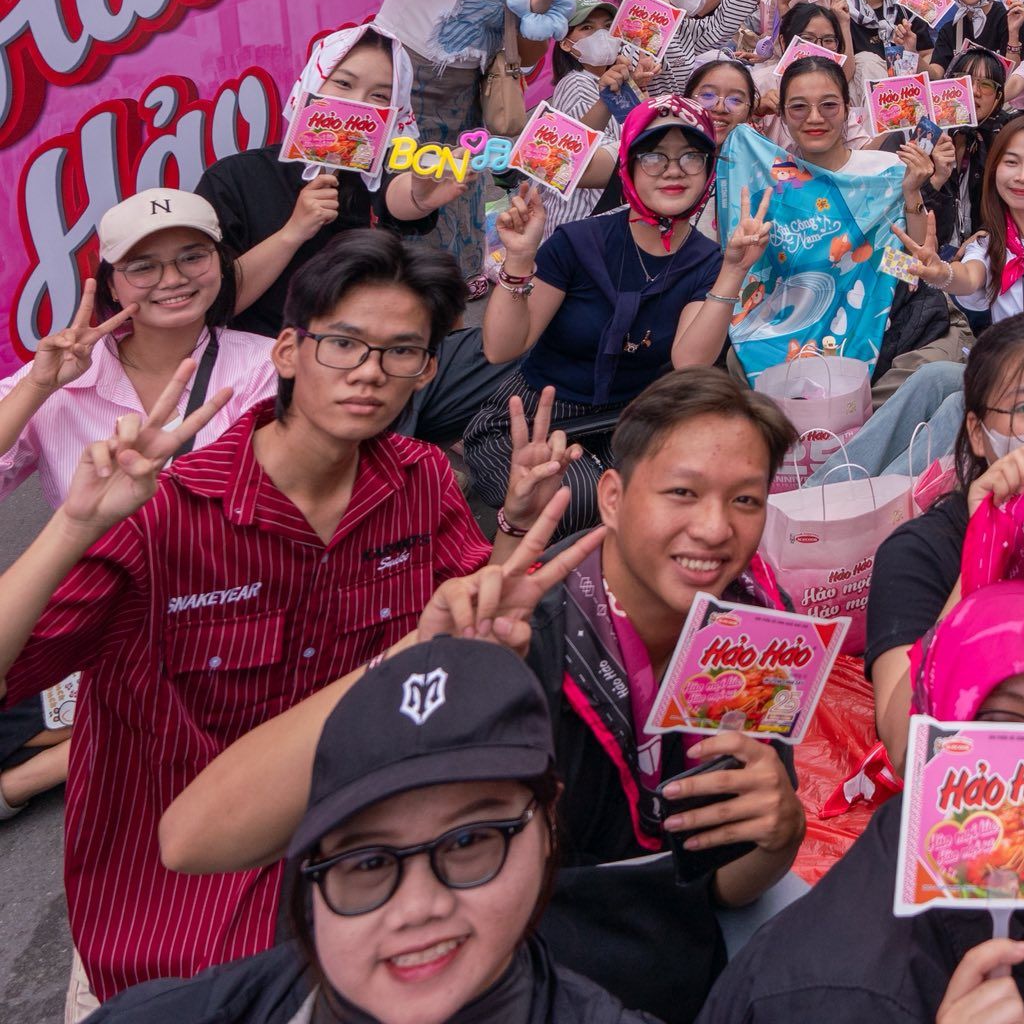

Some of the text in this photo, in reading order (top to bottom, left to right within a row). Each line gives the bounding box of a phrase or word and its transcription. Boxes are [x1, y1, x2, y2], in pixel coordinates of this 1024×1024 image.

[628, 4, 671, 27] Hảo Hảo
[878, 83, 921, 105] Hảo Hảo
[942, 84, 963, 101] Hảo
[306, 110, 378, 135] Hảo Hảo
[532, 123, 583, 155] Hảo Hảo
[390, 136, 471, 183] BCN
[150, 199, 171, 215] N
[829, 558, 873, 583] Hảo Hảo
[168, 581, 263, 614] SNAKEYEAR
[700, 634, 813, 669] Hảo Hảo
[938, 761, 1005, 810] Hảo
